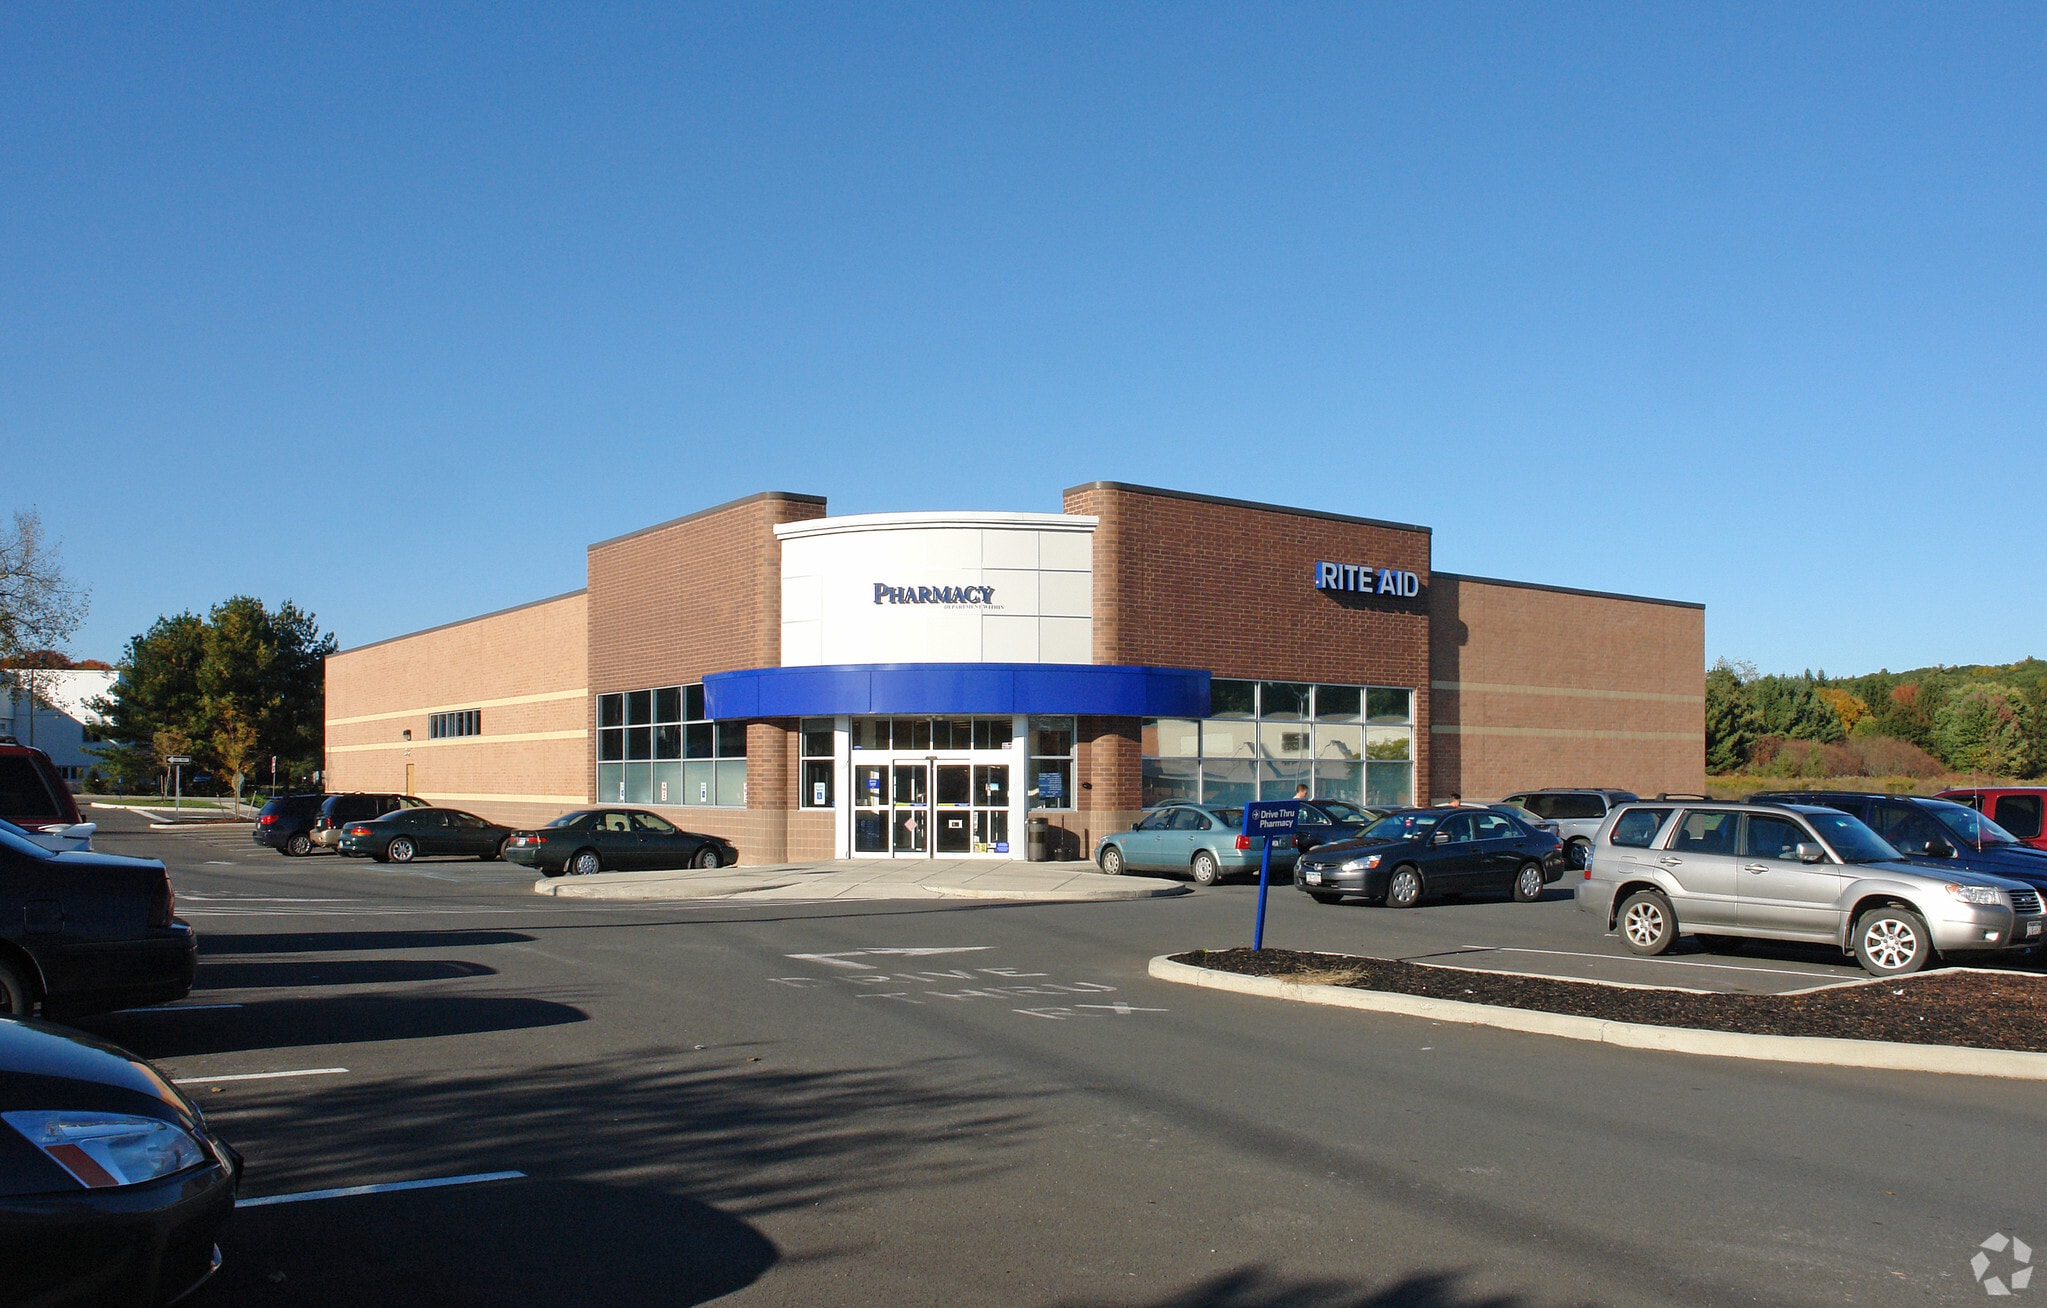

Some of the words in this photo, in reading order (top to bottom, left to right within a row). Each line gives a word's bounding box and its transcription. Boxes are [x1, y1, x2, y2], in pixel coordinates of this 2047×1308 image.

[1315, 561, 1373, 593] RITE
[1376, 568, 1419, 598] AID
[873, 582, 995, 604] PHARMACY
[1259, 820, 1294, 828] Pharmacy
[1260, 810, 1279, 819] Drive
[1280, 809, 1295, 818] Thru
[767, 967, 1050, 988] DRIVE
[856, 982, 1118, 1004] THRU
